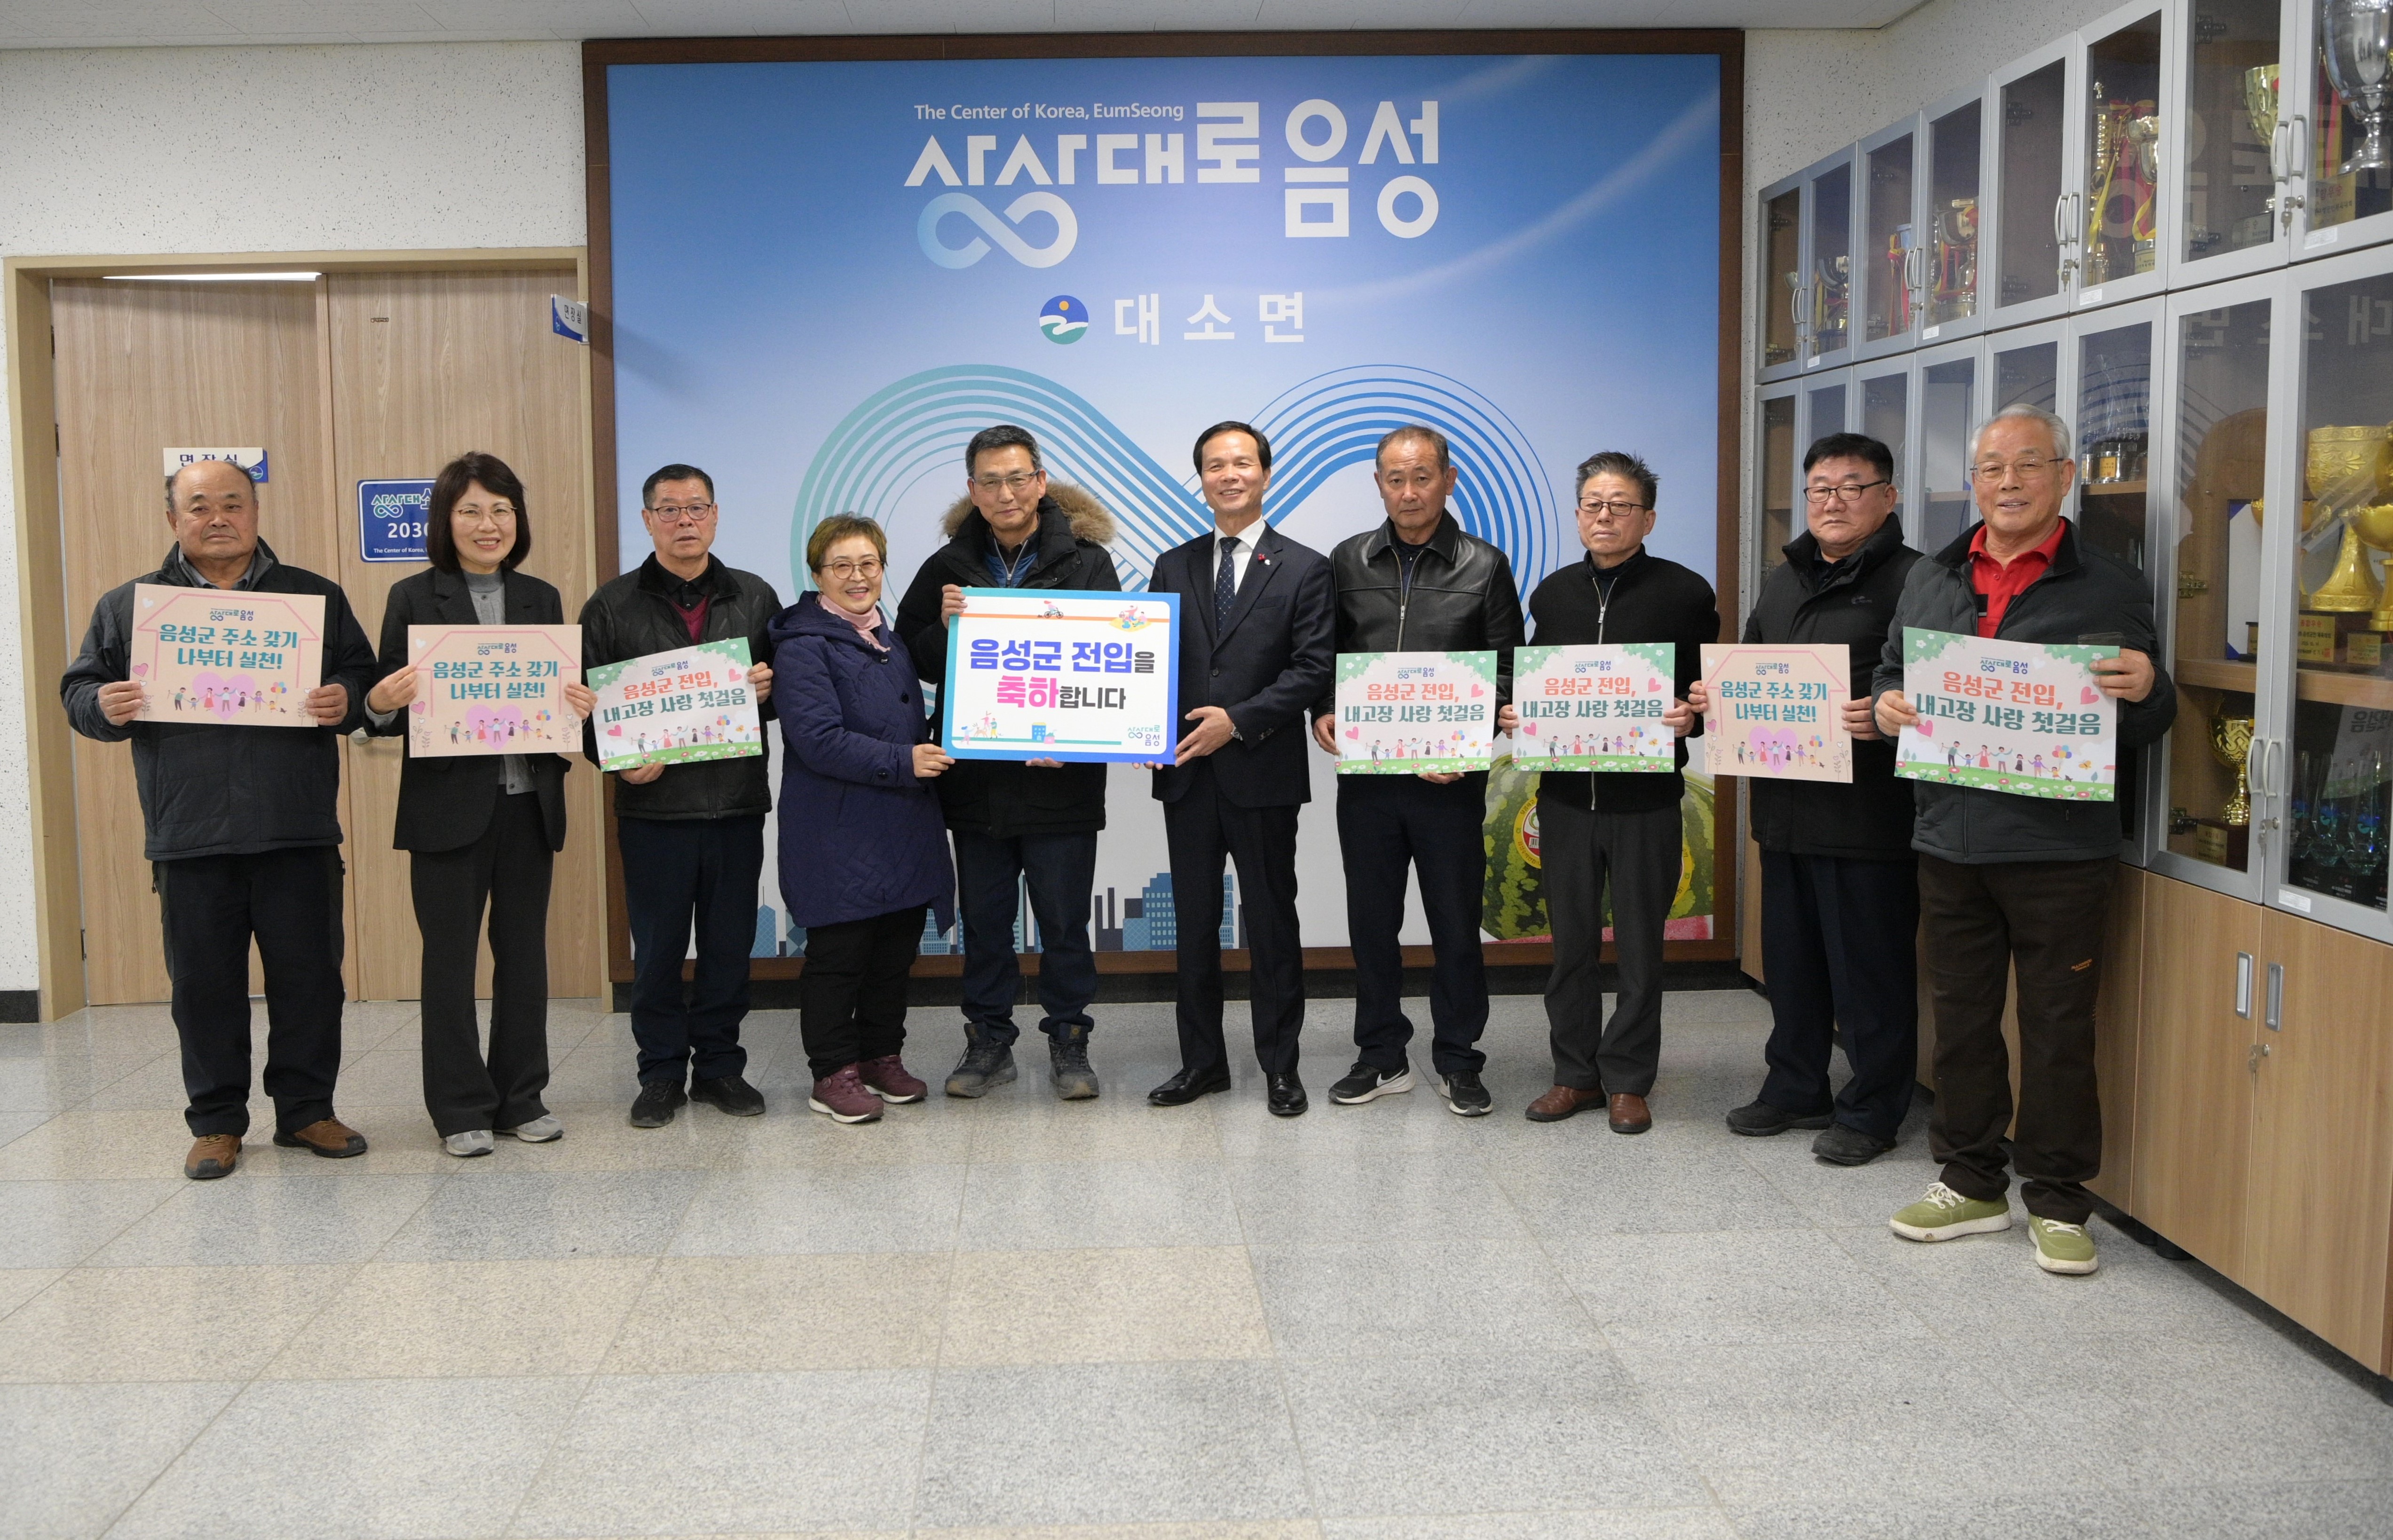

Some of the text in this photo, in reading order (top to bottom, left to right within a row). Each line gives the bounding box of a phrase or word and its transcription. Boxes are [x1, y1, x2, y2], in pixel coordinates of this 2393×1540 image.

[914, 103, 1184, 121] The Center of Korea, EumSeong
[1285, 99, 1439, 238] 음성
[564, 305, 581, 324] 면장실
[241, 610, 254, 621] 음성
[159, 624, 297, 648] 음성군 주소 갖기
[505, 643, 517, 653] 음성
[970, 639, 1155, 673] 음성군 전입을
[177, 648, 282, 669] 나부터 실천!
[676, 660, 688, 671] 음성
[1600, 660, 1611, 671] 음성
[2013, 661, 2028, 674] 음성
[433, 661, 558, 679] 음성군 주소 갖기
[1423, 667, 1434, 677] 음성
[1778, 663, 1789, 674] 음성
[451, 682, 545, 699] 나부터 실천!
[624, 671, 718, 700] 음성군 전입,
[996, 675, 1126, 710] 축하합니다
[1367, 683, 1459, 703] 음성군 전입,
[1544, 677, 1636, 697] 음성군 전입,
[1721, 681, 1827, 701] 음성군 주소 갖기
[1943, 671, 2063, 710] 음성군 전입,
[603, 688, 746, 723] 내고장 사랑 첫걸음
[1345, 704, 1485, 723] 내고장 사랑 첫걸음
[1523, 699, 1663, 718] 내고장 사랑 첫걸음
[1735, 703, 1816, 723] 나부터 실천!
[1916, 693, 2101, 735] 내고장 사랑 첫걸음
[1145, 734, 1160, 747] 음성
